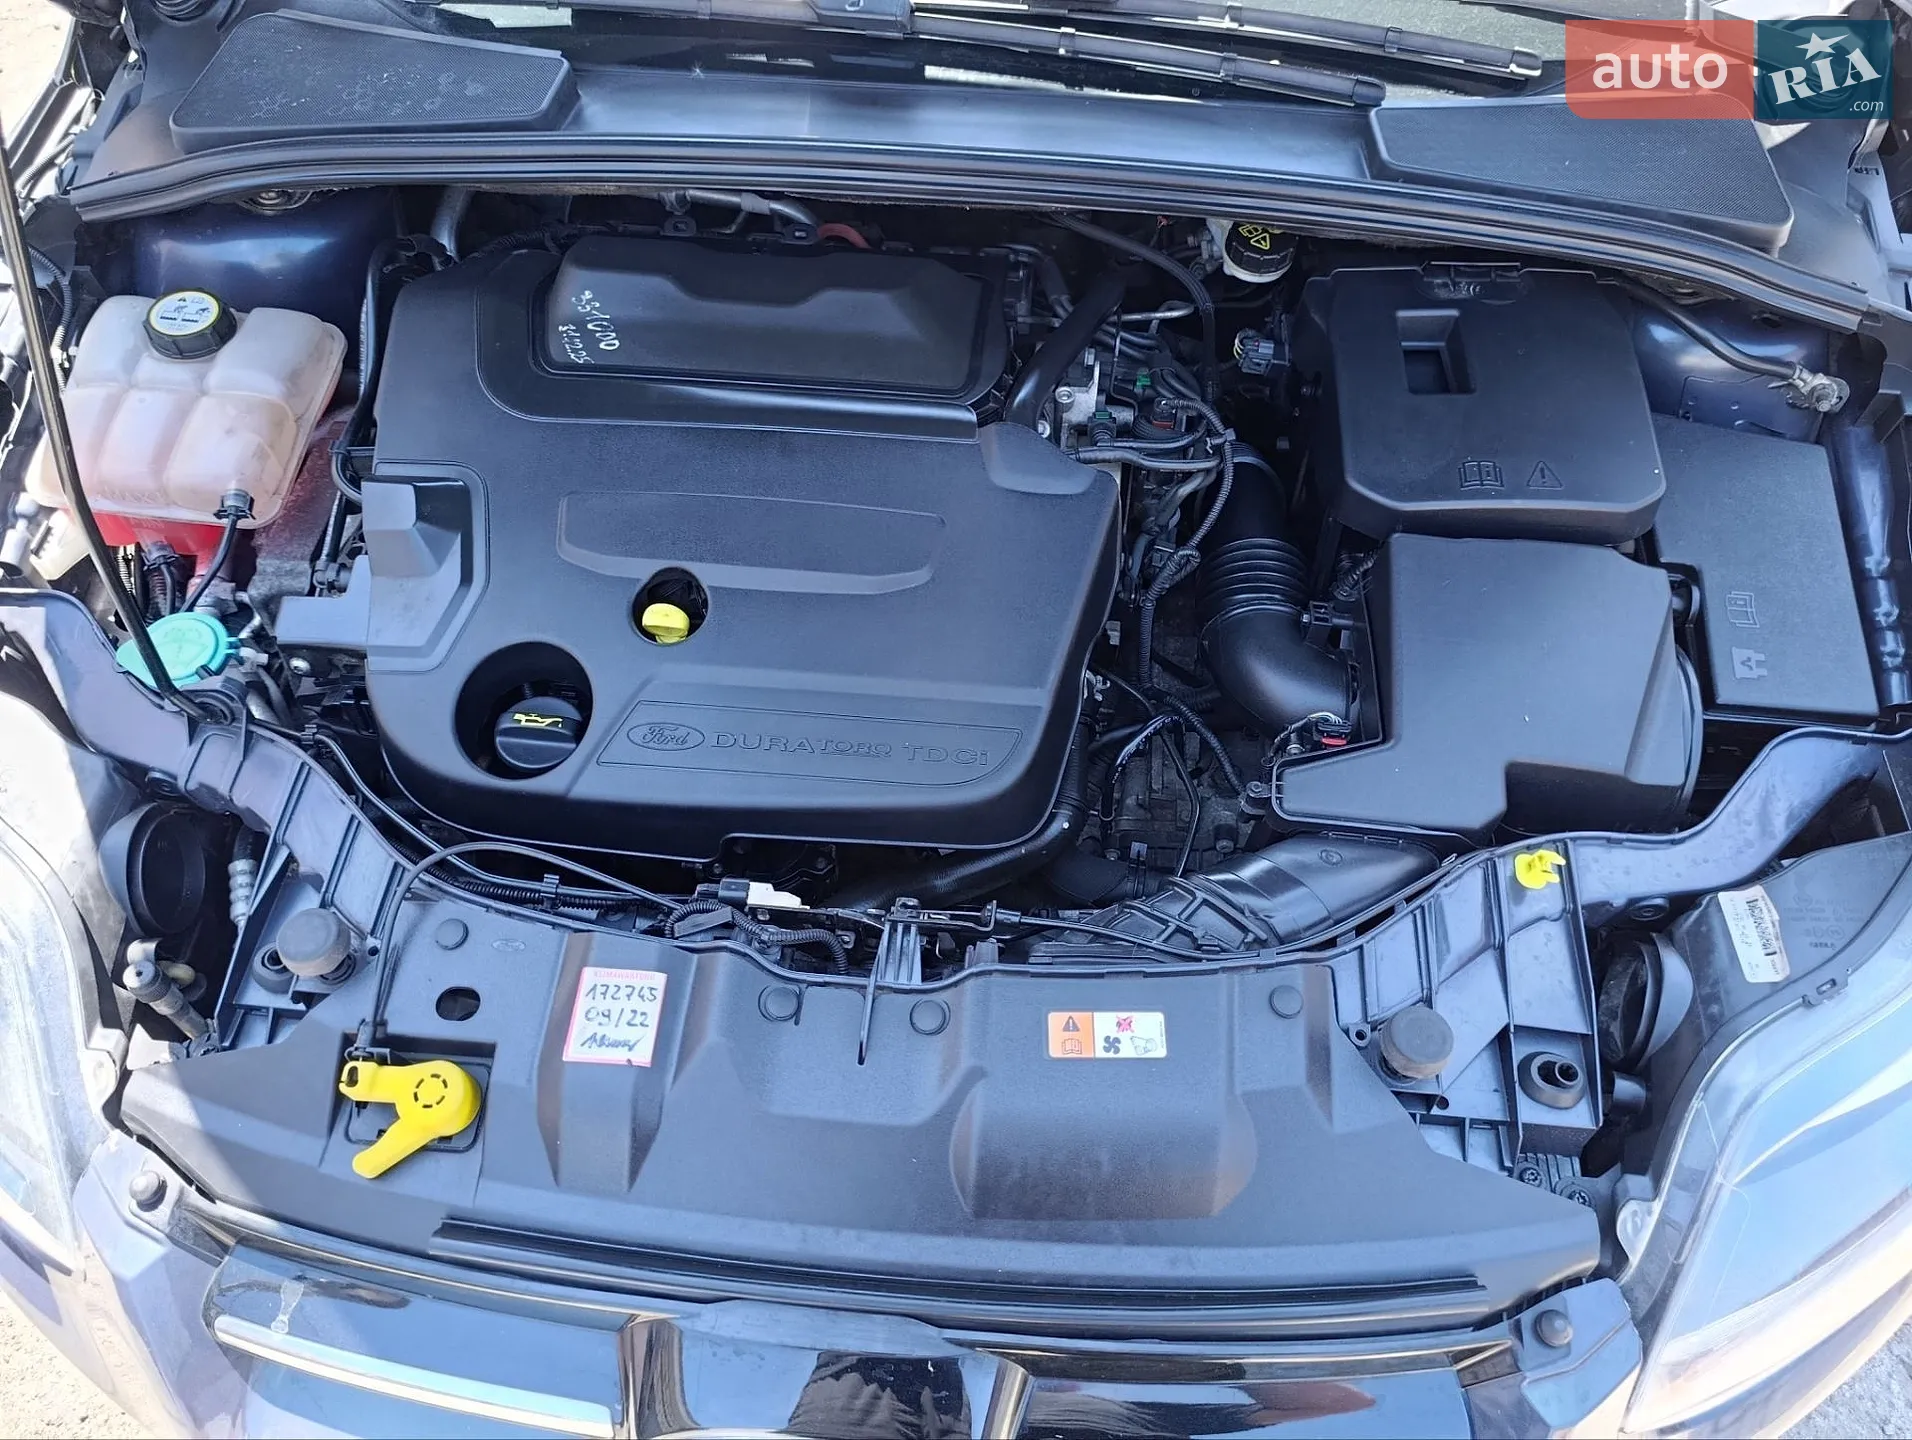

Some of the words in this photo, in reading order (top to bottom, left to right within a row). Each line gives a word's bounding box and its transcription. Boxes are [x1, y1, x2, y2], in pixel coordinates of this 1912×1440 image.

[641, 725, 689, 747] Ford
[902, 745, 988, 766] TDCi
[585, 983, 658, 1002] 172745
[584, 1006, 650, 1029] 09/22
